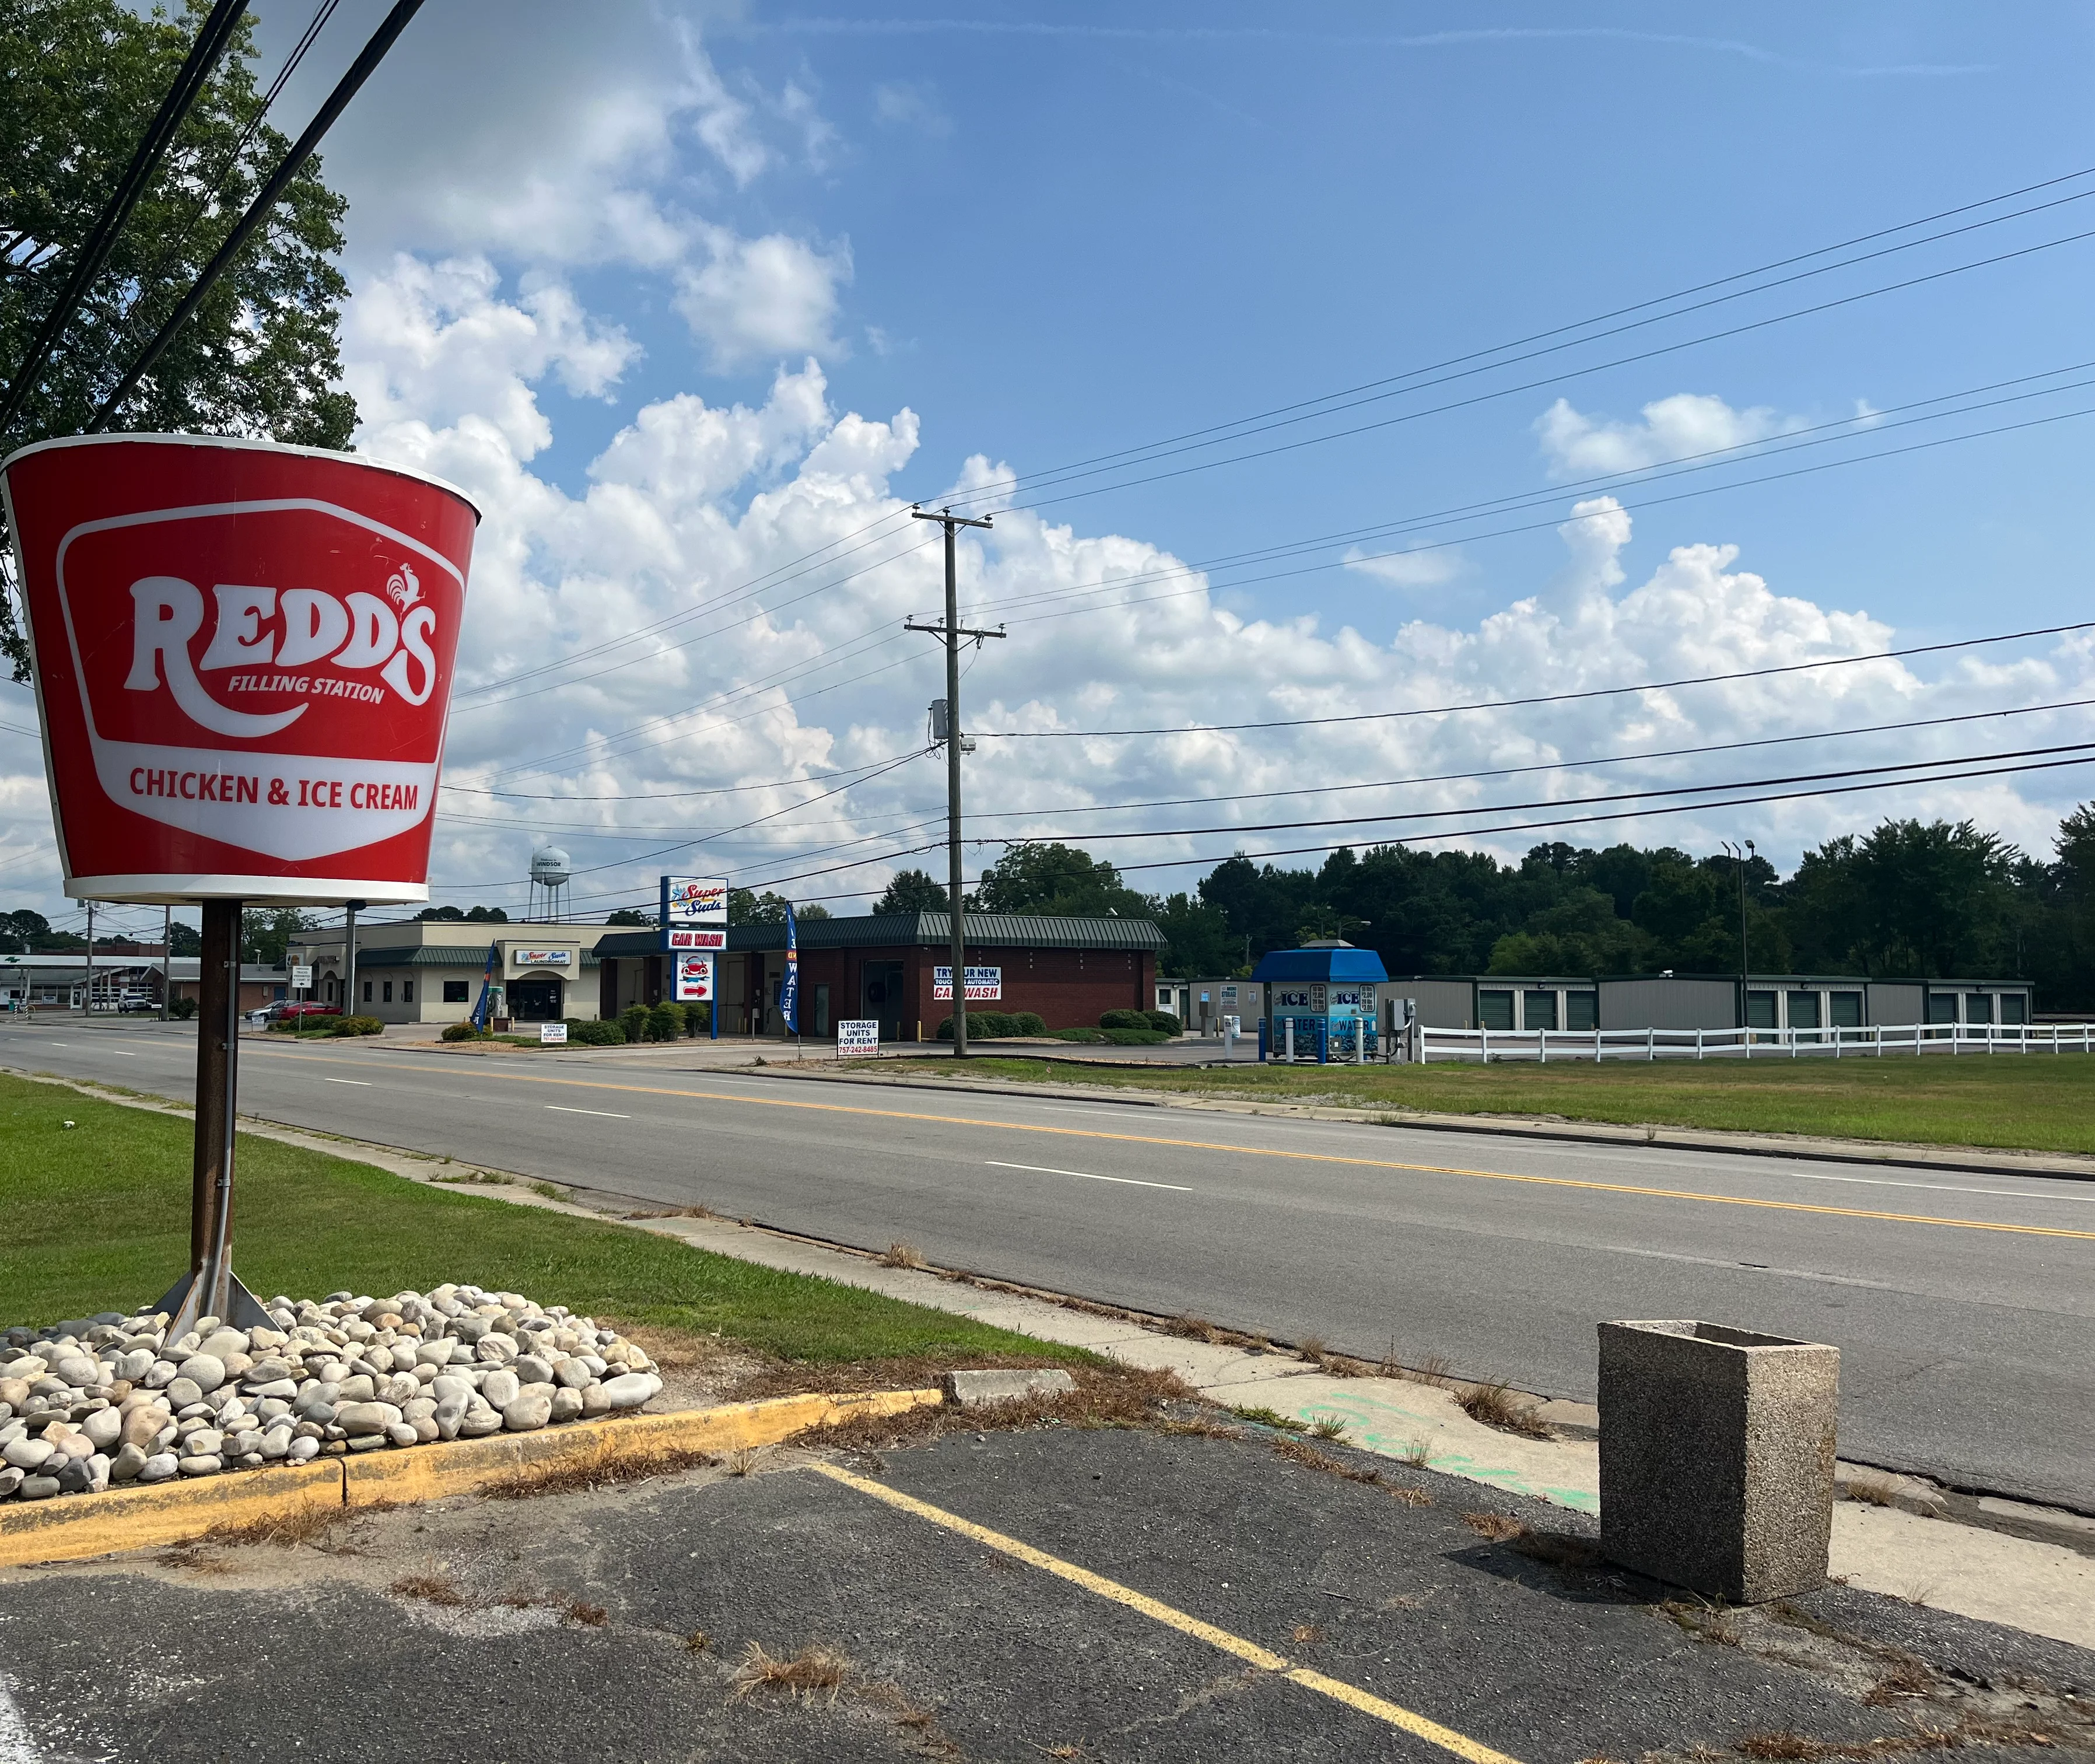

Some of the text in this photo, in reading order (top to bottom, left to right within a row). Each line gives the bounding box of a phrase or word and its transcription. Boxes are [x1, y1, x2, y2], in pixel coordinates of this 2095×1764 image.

[227, 675, 385, 705] FILLING STATION
[129, 767, 418, 810] CHICKEN & ICE CREAM
[681, 884, 726, 901] Super
[685, 900, 721, 916] Suds
[671, 933, 724, 947] CAR WASH
[527, 951, 566, 960] Super Suds
[936, 968, 953, 977] TRY
[978, 969, 997, 977] NEW
[934, 988, 998, 998] CA WASH
[1281, 991, 1308, 1006] ICE
[1336, 991, 1360, 1005] ICE
[839, 1045, 878, 1054] 757-242-8485
